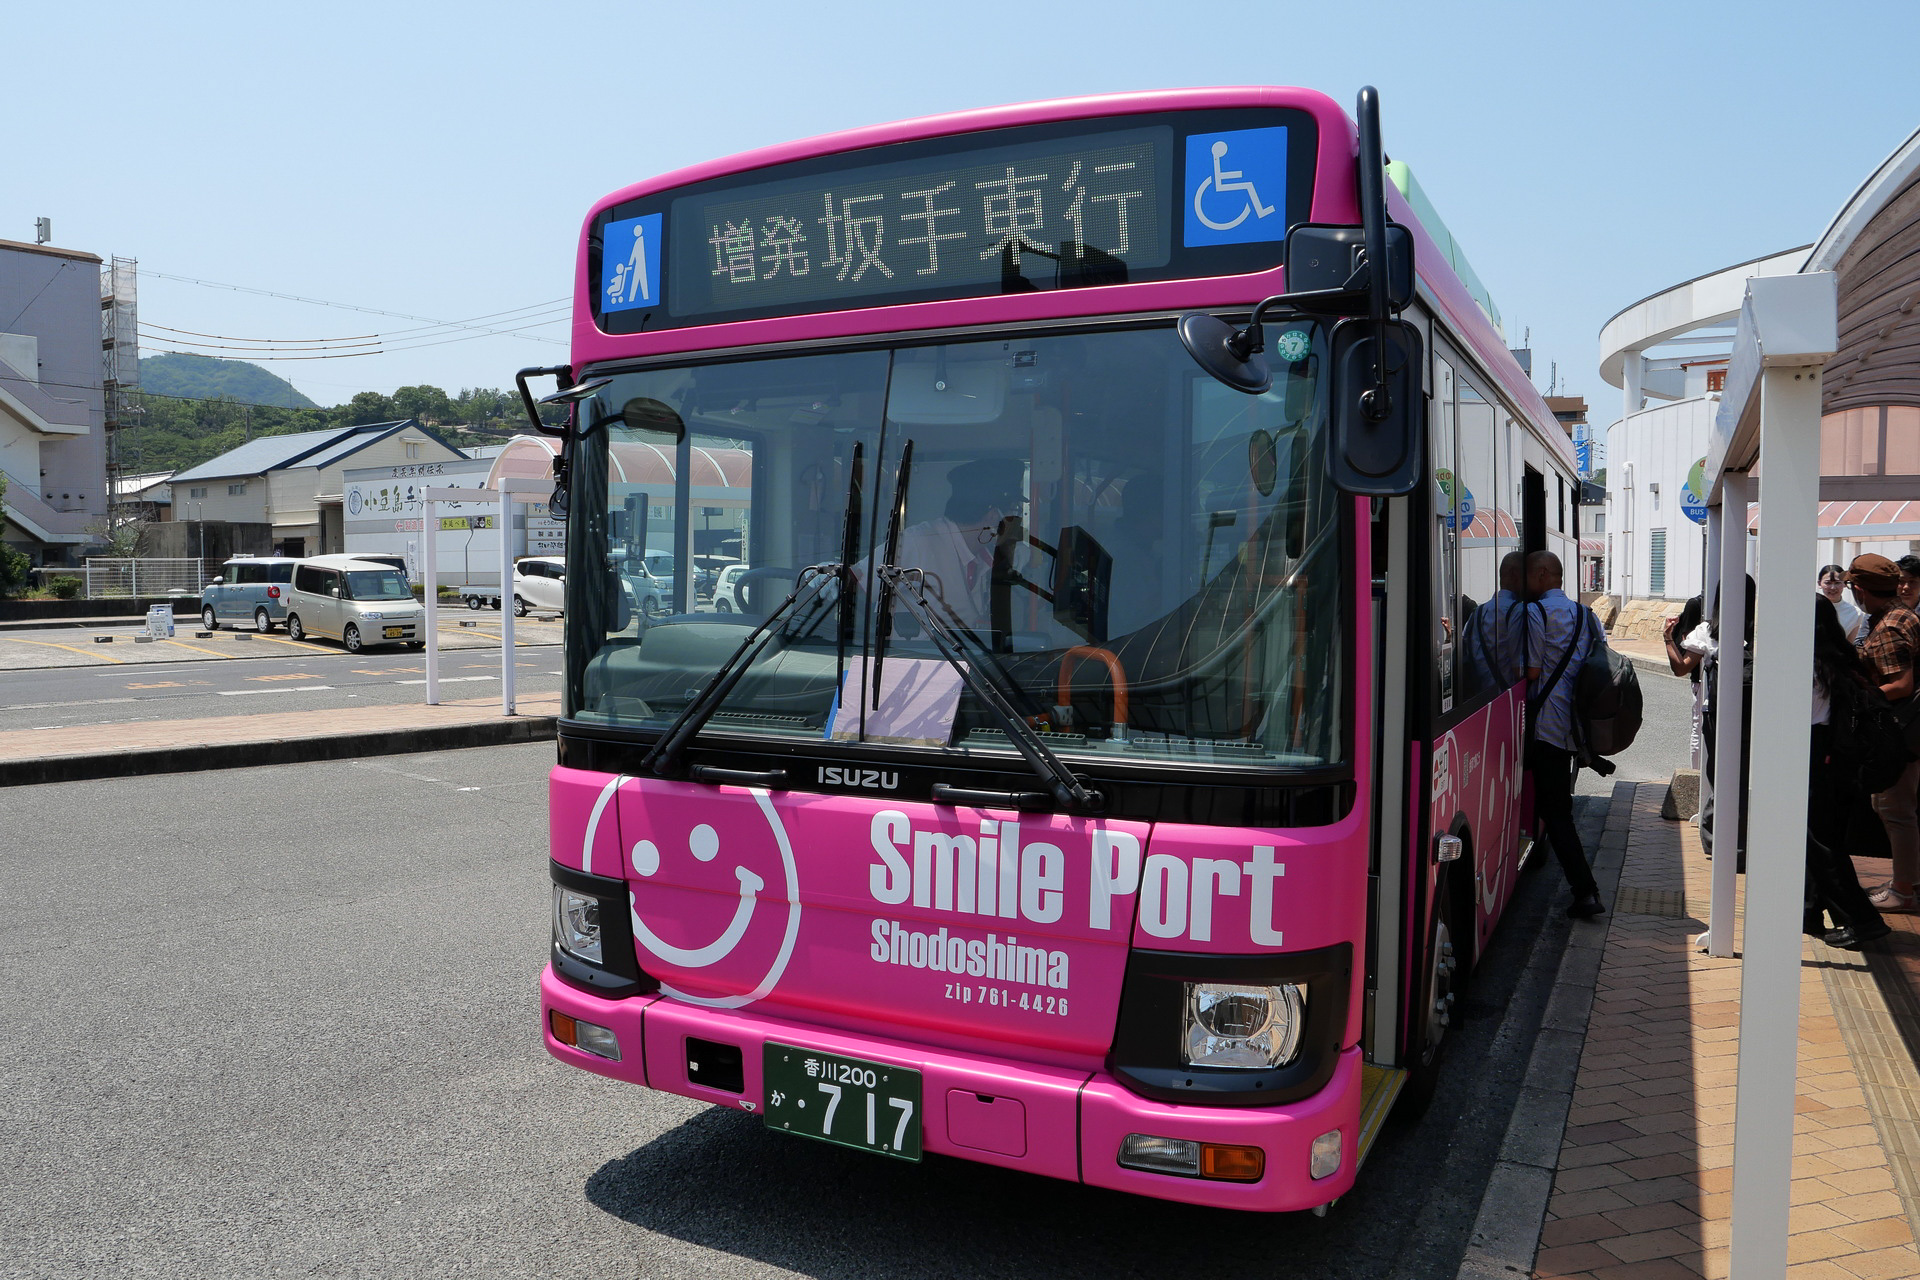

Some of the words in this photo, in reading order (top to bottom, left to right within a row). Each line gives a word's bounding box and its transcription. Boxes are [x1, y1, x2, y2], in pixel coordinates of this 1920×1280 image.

[1291, 341, 1298, 351] 7
[818, 766, 899, 790] ISUZU
[869, 810, 1065, 924] Smile
[1089, 829, 1286, 947] Port
[870, 918, 1069, 990] Shodoshima
[945, 983, 972, 1004] zip
[978, 985, 1069, 1017] 761-4426
[770, 1089, 786, 1107] か
